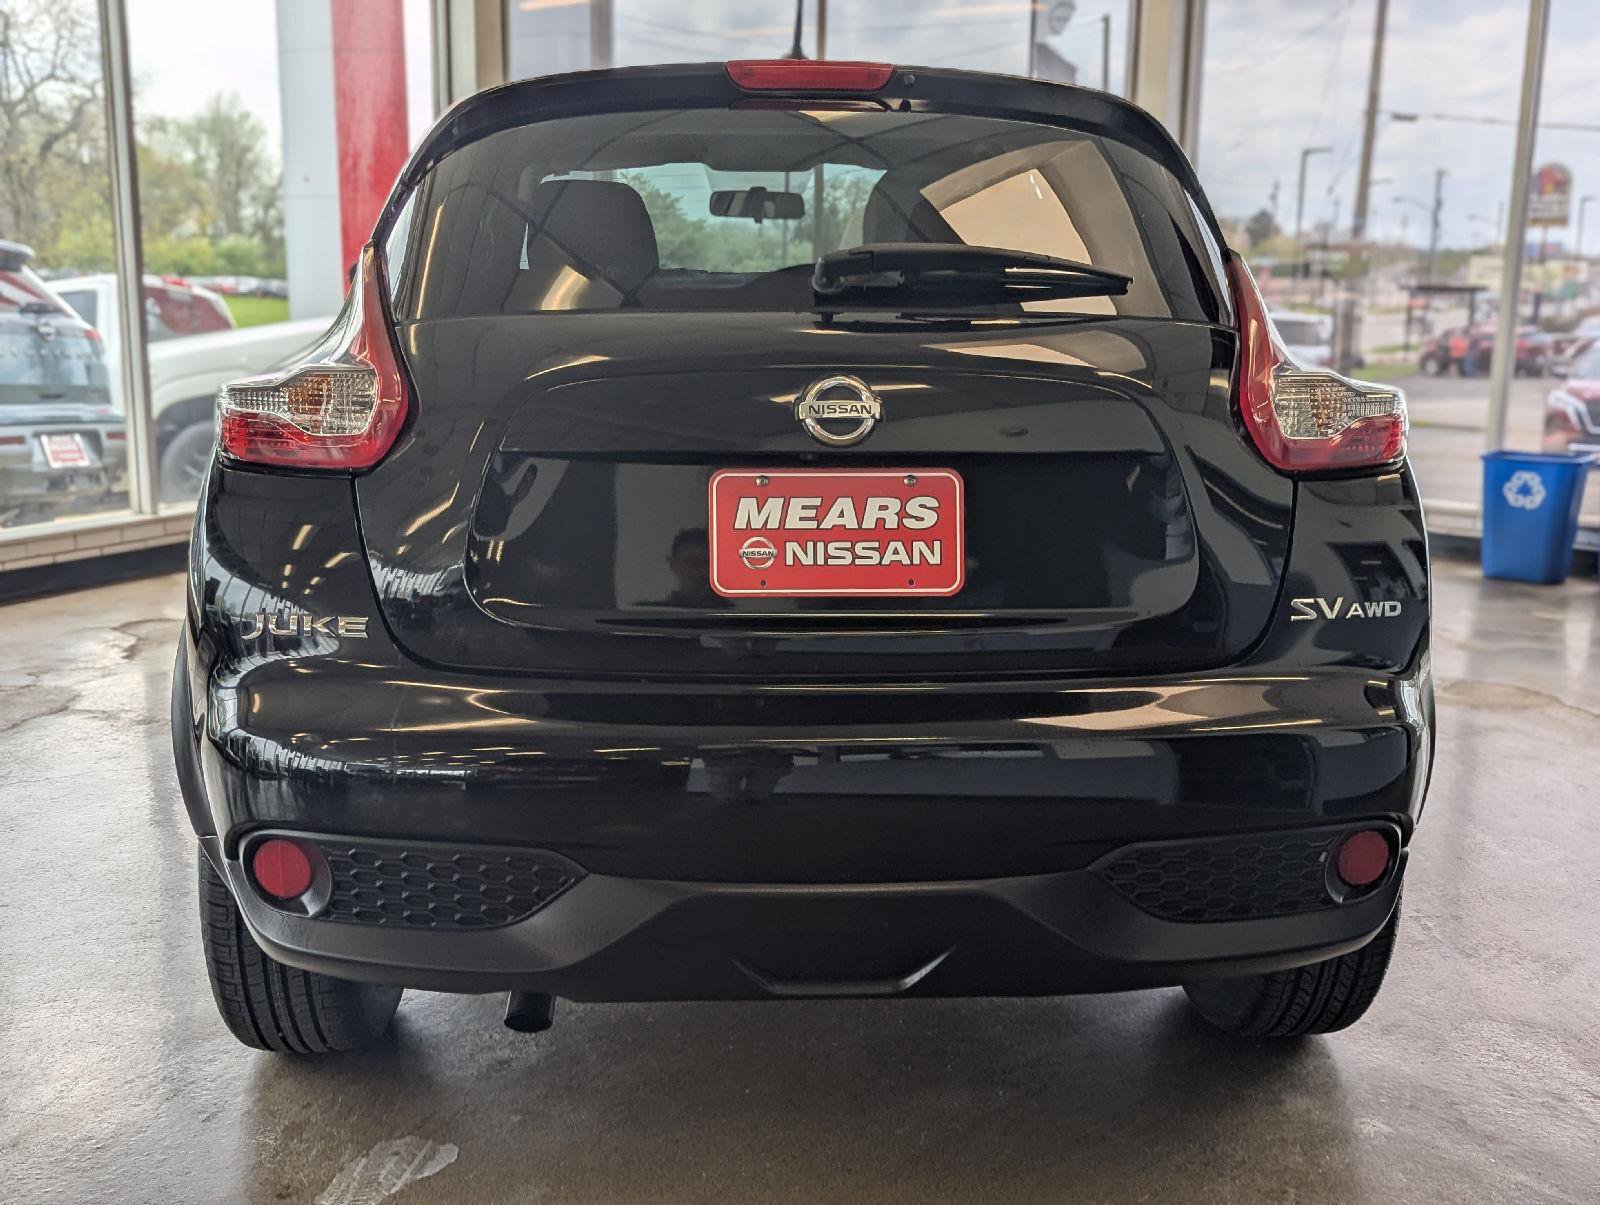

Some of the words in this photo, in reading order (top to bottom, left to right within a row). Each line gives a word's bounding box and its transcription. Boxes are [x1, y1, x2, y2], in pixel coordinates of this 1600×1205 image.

[808, 404, 873, 415] NISSAN
[734, 497, 939, 530] MEARS
[785, 541, 942, 566] NISSAN
[1290, 597, 1344, 621] SV
[1345, 601, 1402, 619] AWD
[241, 614, 368, 639] JUKE
